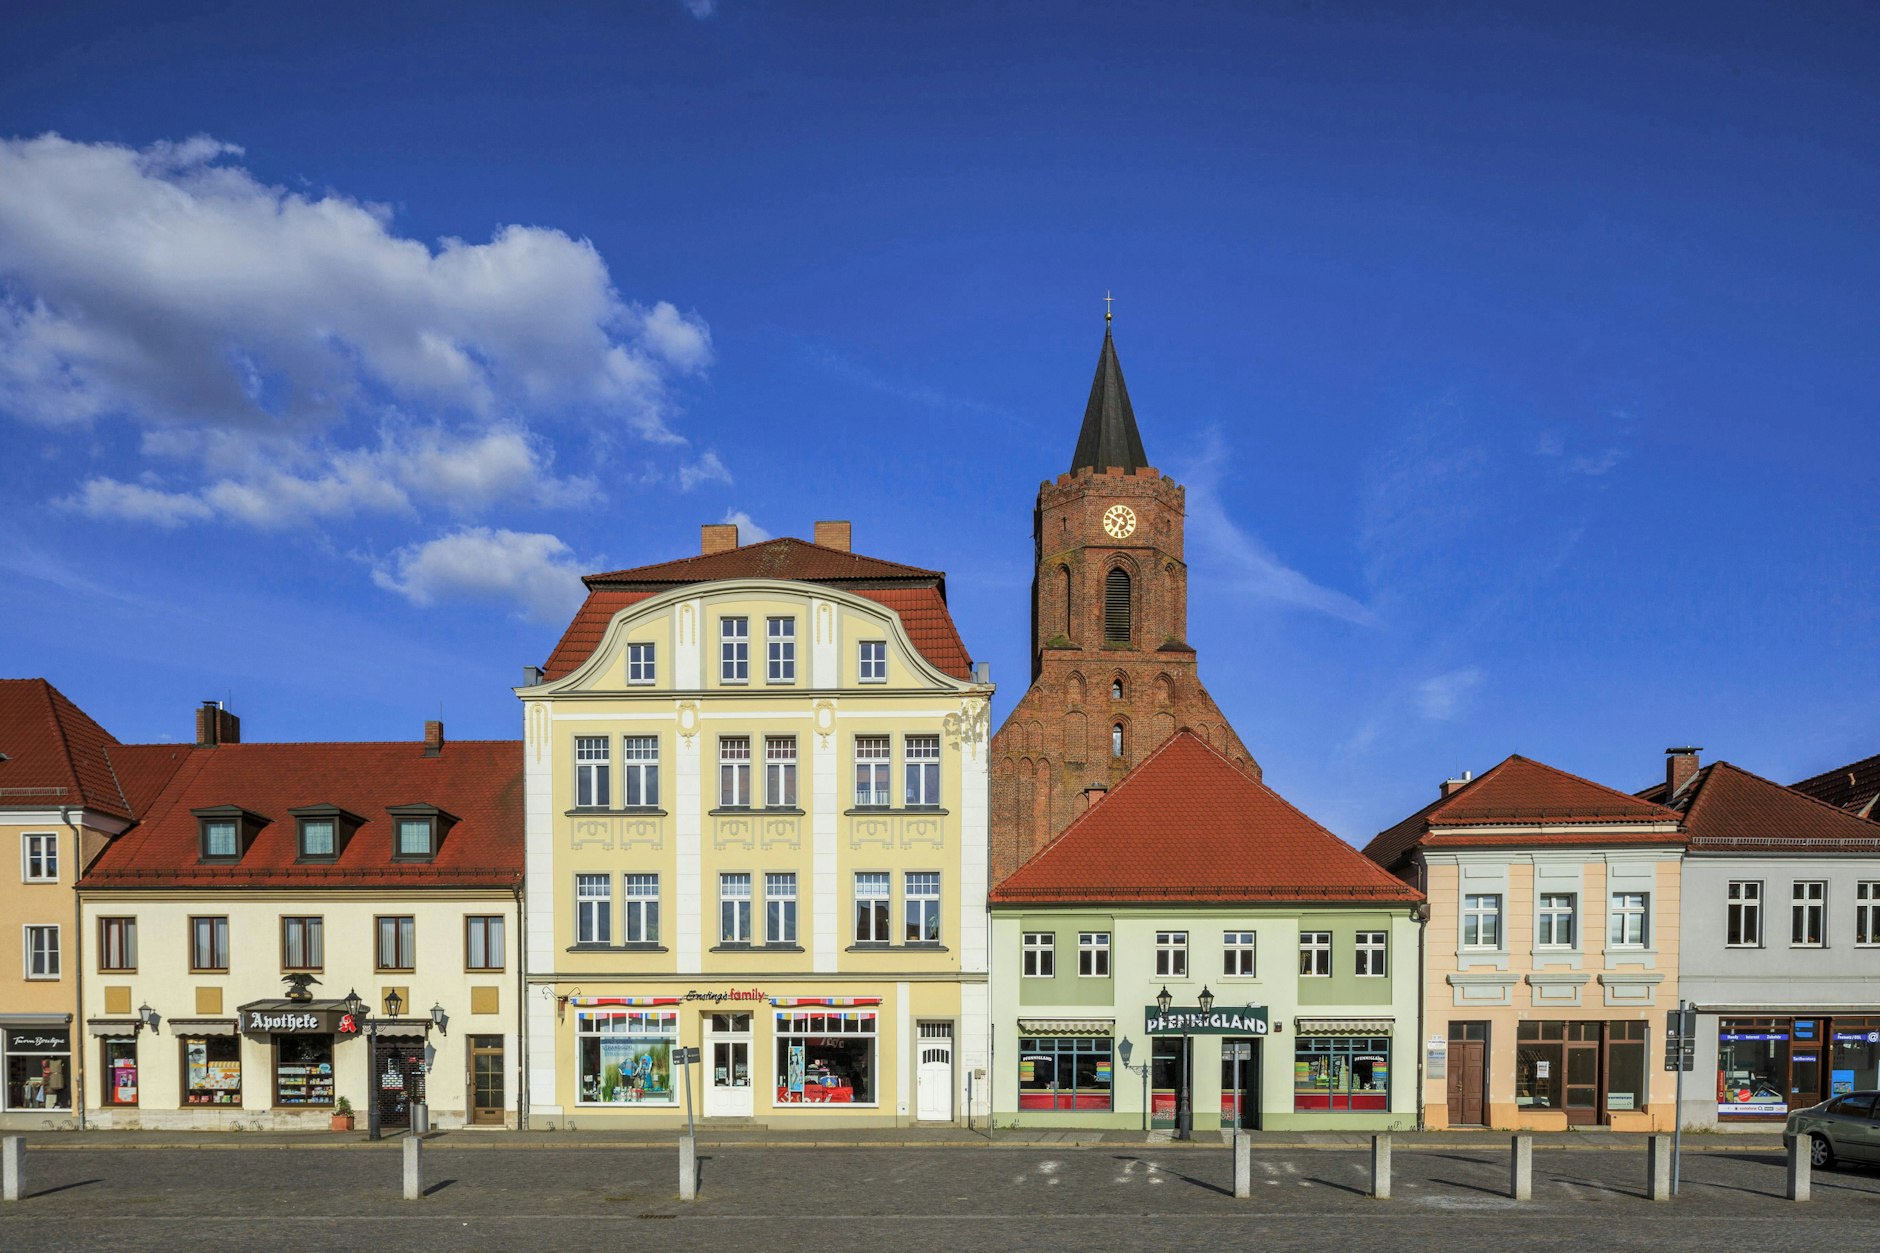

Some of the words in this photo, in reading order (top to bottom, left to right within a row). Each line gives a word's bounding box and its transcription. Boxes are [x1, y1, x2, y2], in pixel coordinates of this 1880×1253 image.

[686, 990, 728, 1004] Ernsting's
[730, 988, 765, 1003] family
[250, 1012, 318, 1032] Apotheke
[1147, 1013, 1268, 1034] PFENNIGLAND
